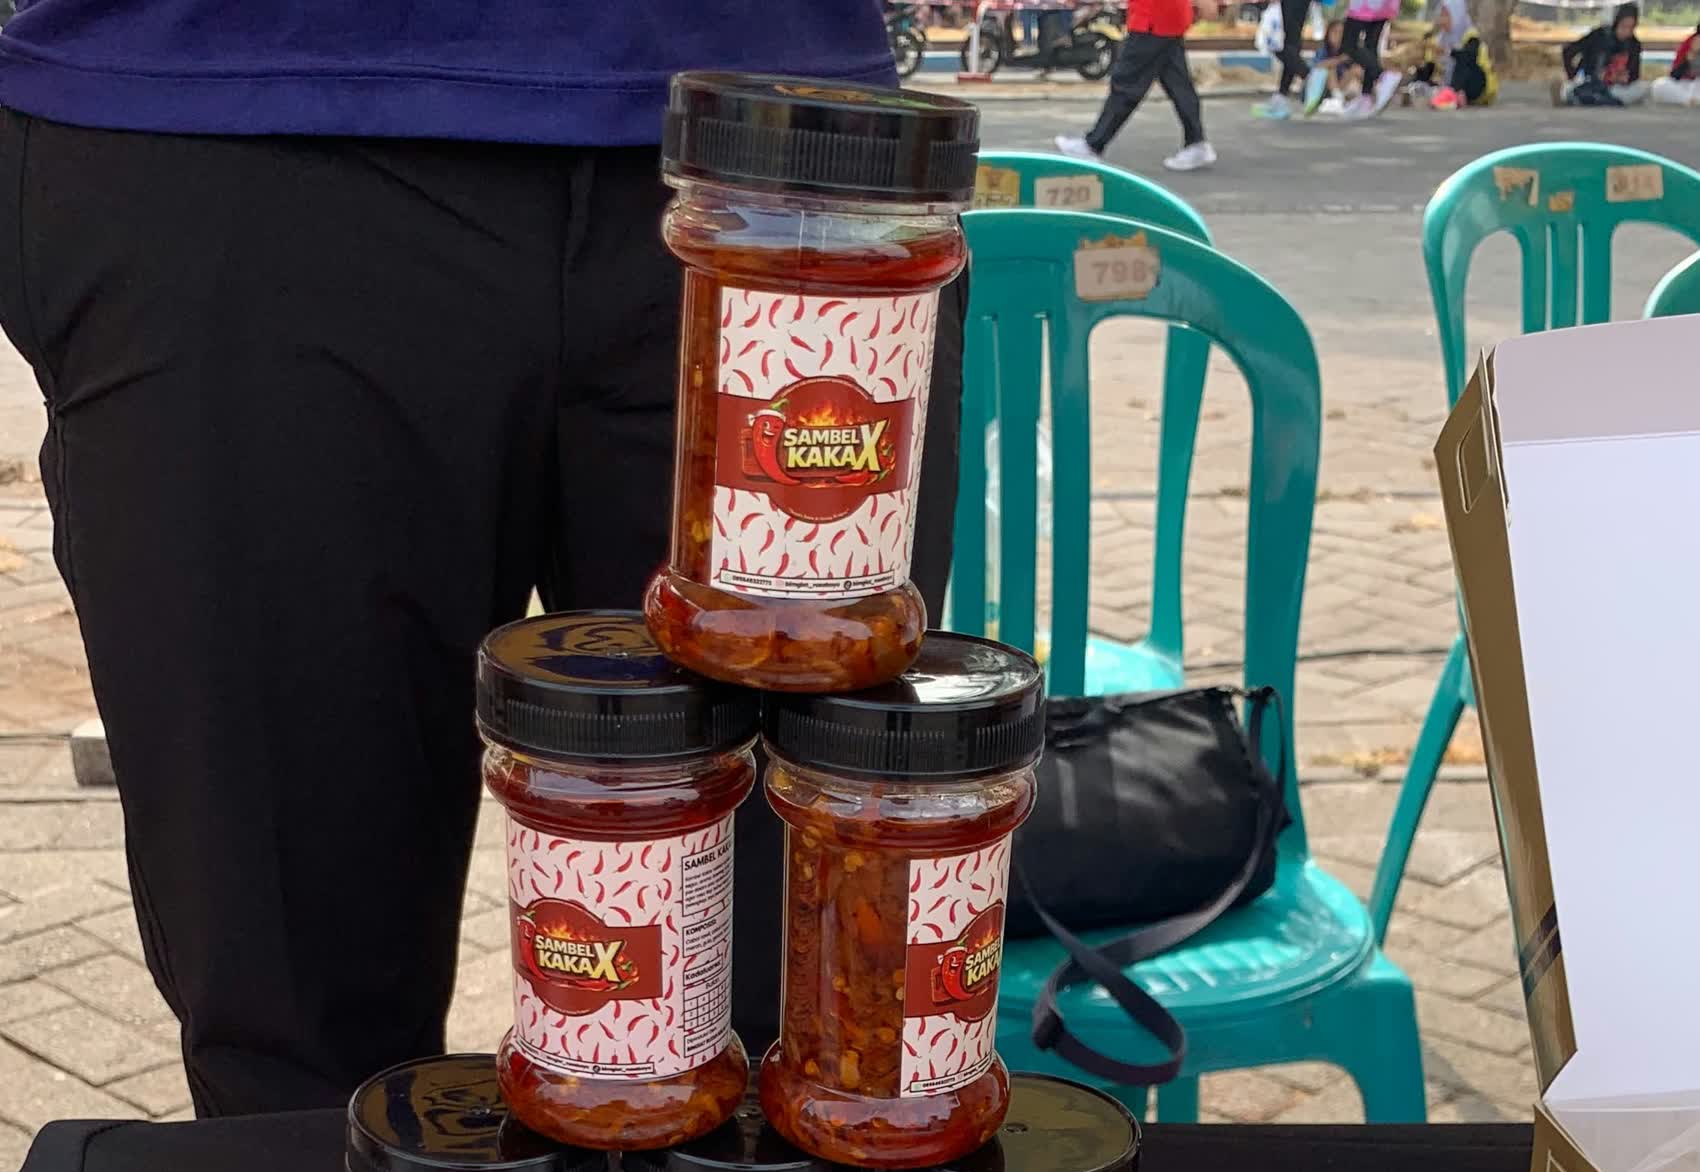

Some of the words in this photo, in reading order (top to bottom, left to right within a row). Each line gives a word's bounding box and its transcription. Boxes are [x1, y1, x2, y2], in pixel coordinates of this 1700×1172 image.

[783, 427, 860, 447] SAMBEL
[684, 852, 716, 871] SAMBEL
[535, 936, 596, 958] SAMBEL
[965, 937, 1000, 970] SAMBE
[967, 949, 1001, 986] KAKA
